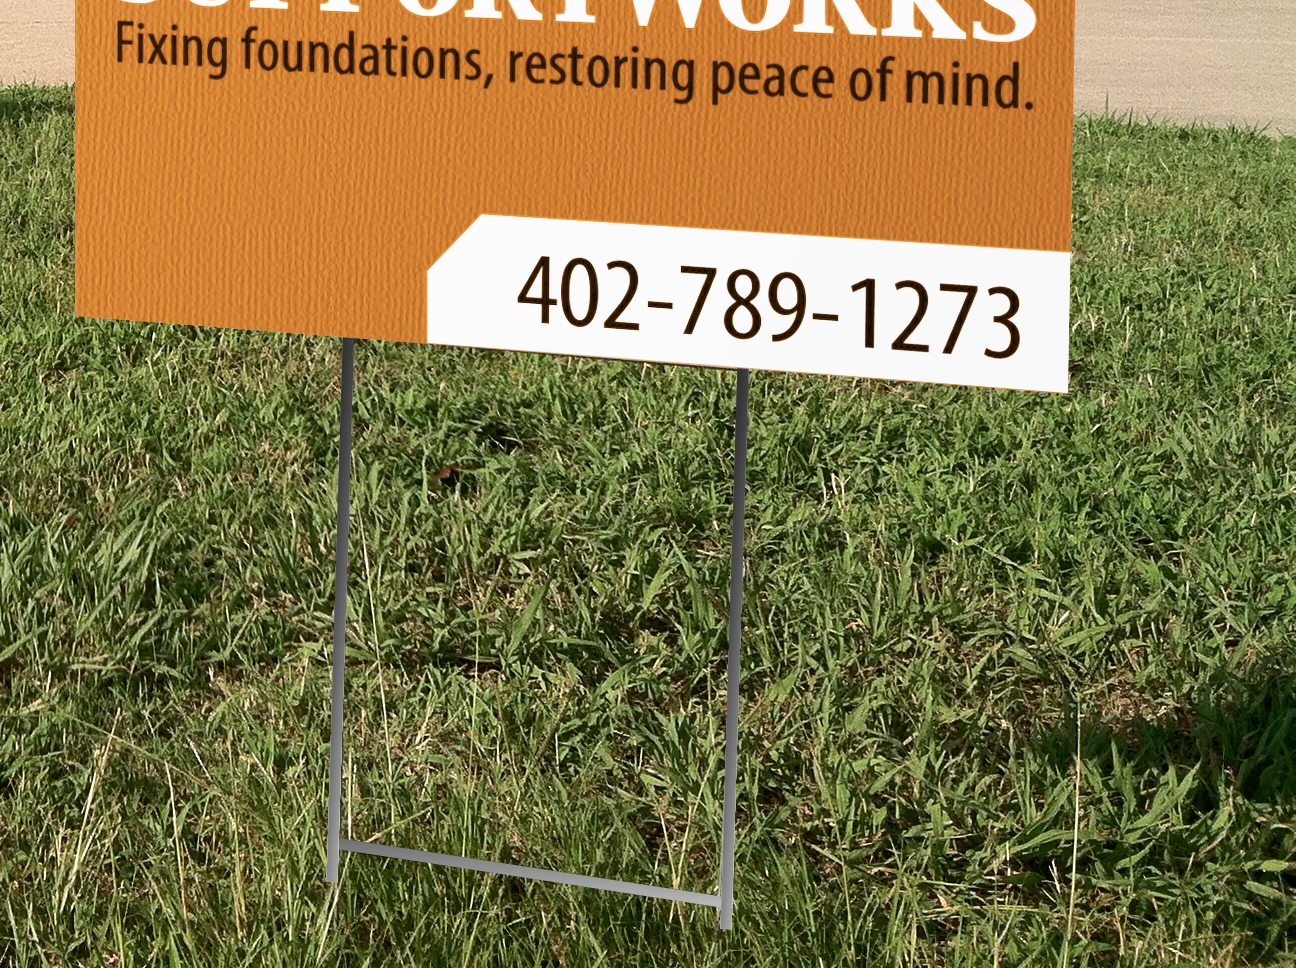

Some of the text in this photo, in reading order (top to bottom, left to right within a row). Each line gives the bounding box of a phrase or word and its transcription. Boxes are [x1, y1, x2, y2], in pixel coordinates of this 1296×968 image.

[117, 20, 1034, 111] Fixing foundations, restoring peace of mind.
[516, 255, 1021, 360] 402-789-1273
